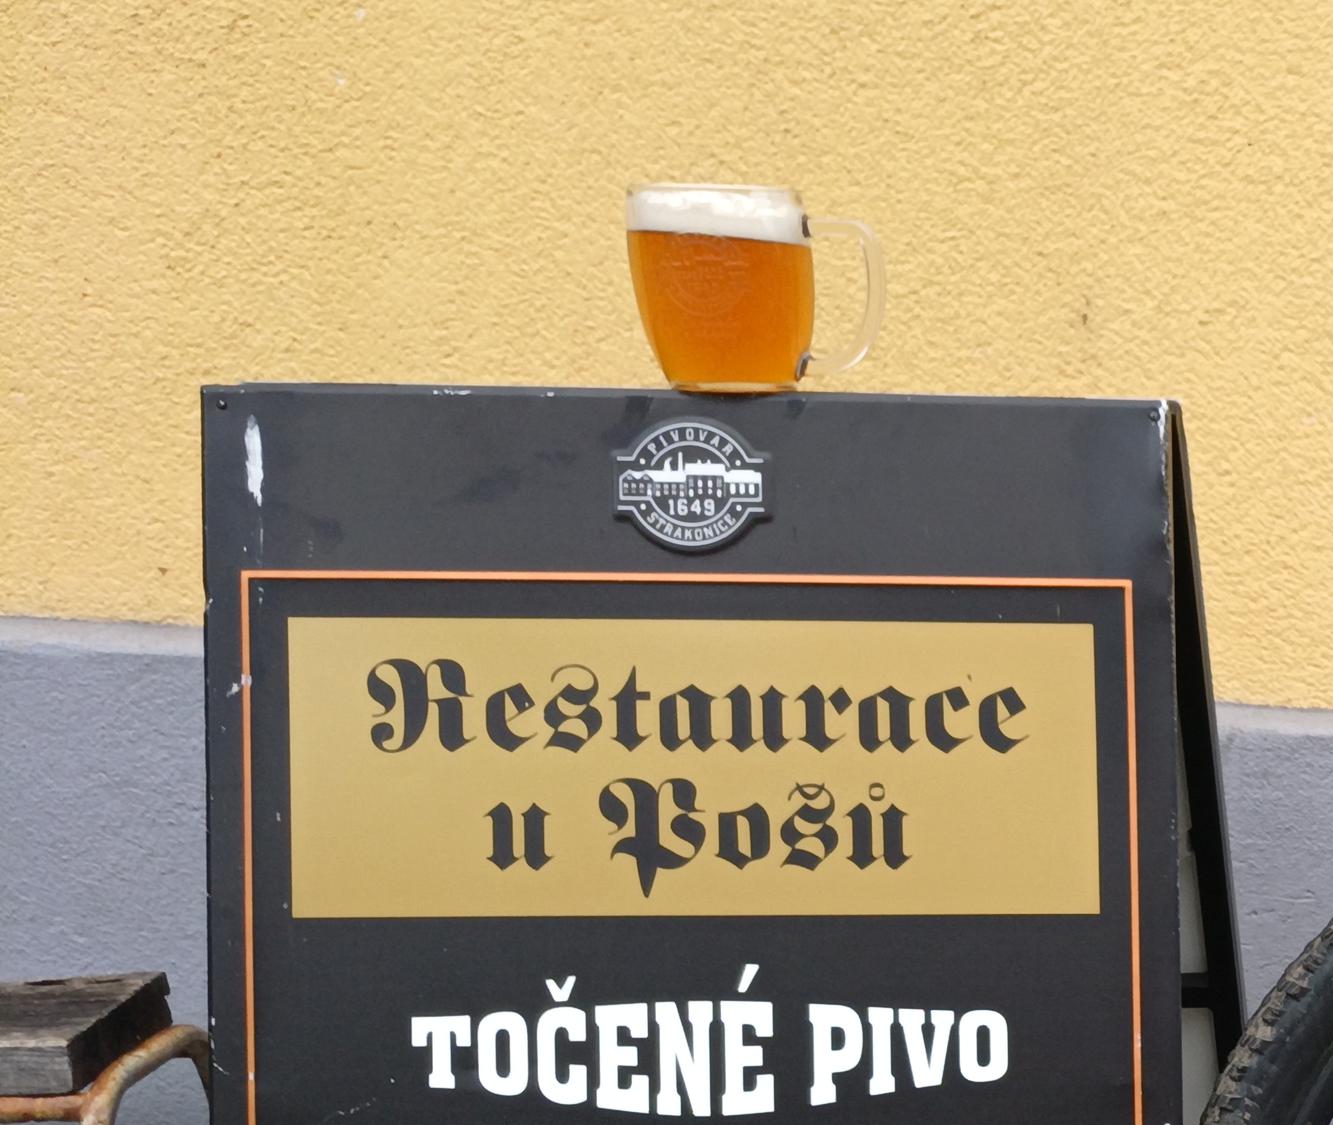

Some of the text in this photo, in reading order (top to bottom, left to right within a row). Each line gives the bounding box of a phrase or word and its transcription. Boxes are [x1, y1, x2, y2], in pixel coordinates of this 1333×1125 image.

[647, 428, 735, 456] PIVOVAR
[647, 512, 737, 541] STRAKONICE
[667, 499, 716, 517] 1649
[366, 657, 1028, 755] Restaurace
[484, 776, 912, 899] u Pošů
[410, 963, 1009, 1117] TOČENÉ PIVO
